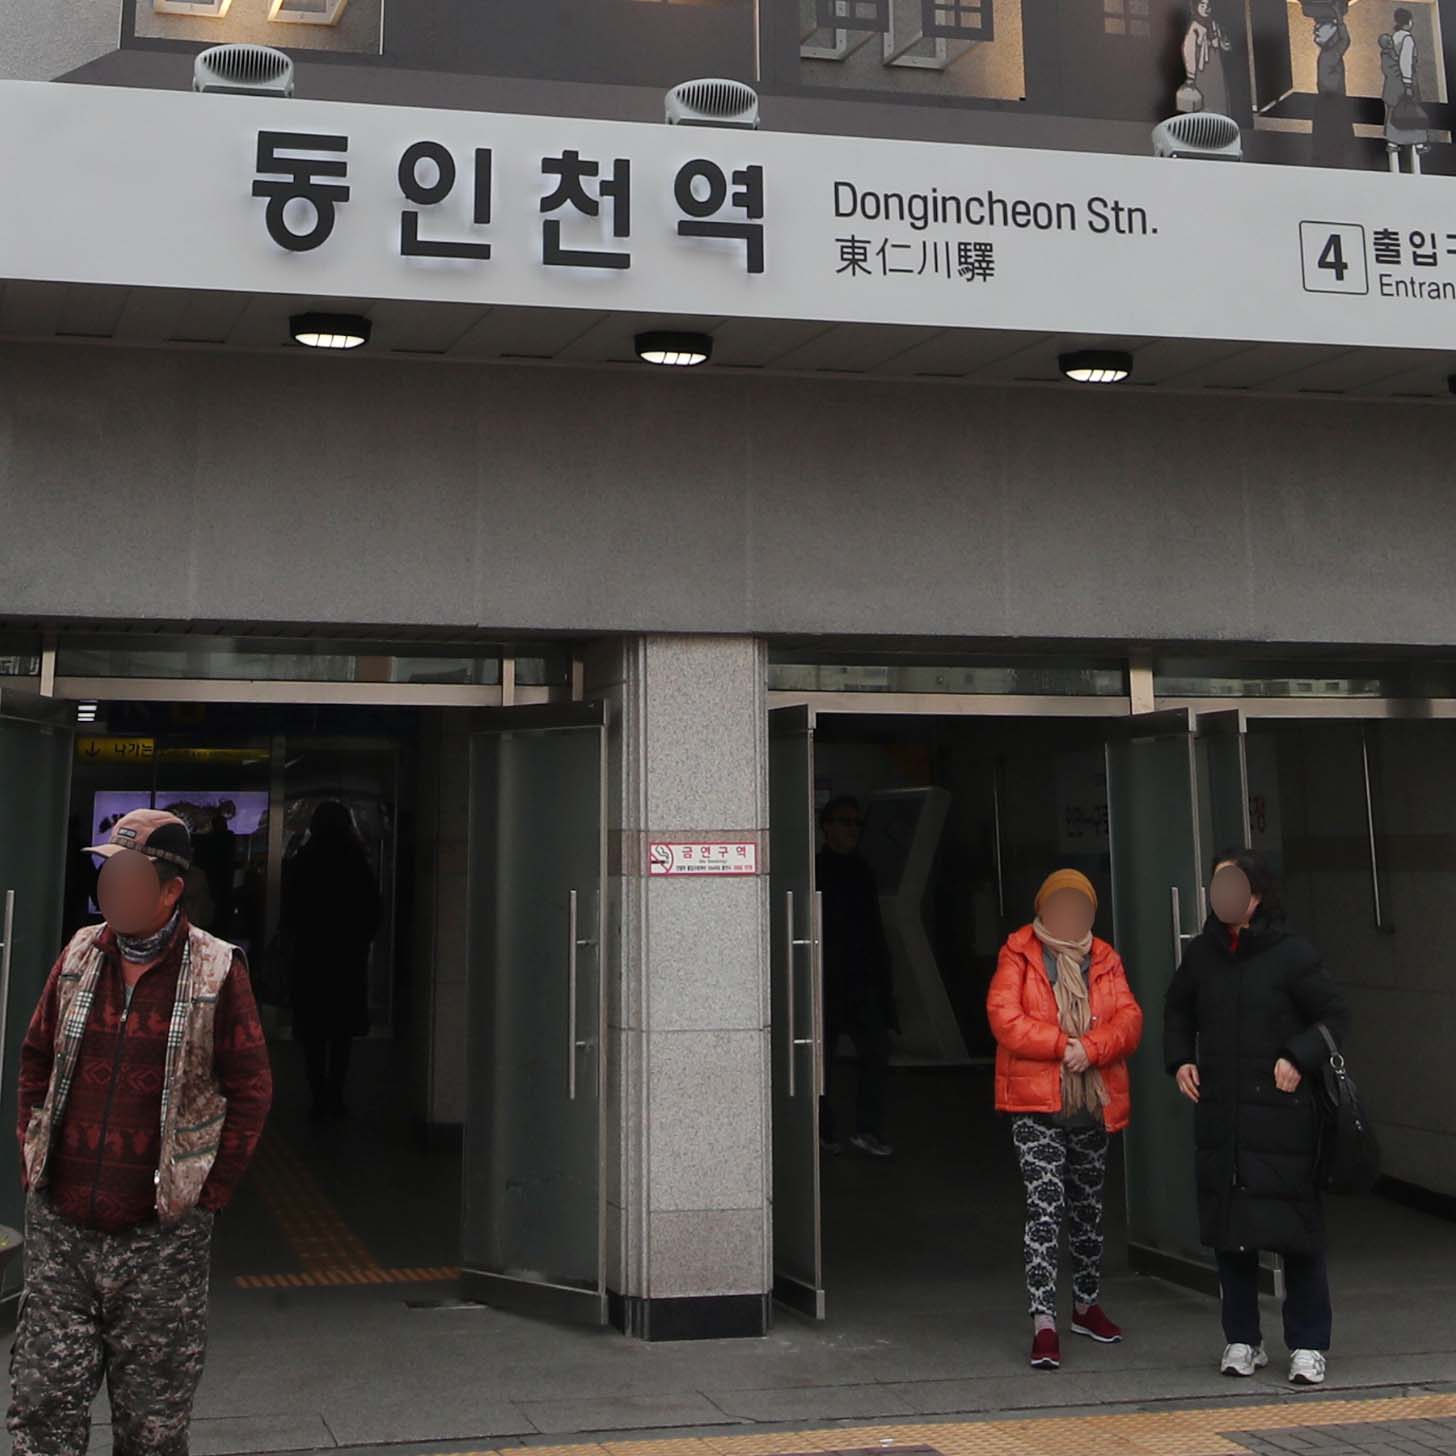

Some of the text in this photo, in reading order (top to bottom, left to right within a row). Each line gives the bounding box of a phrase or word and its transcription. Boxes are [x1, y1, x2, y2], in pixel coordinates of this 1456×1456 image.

[250, 128, 766, 275] 동인천역
[831, 177, 1161, 237] Dongincheon Stn.
[833, 234, 997, 284] 東仁川驛
[1317, 232, 1349, 282] 4
[681, 846, 747, 859] 금연구역
